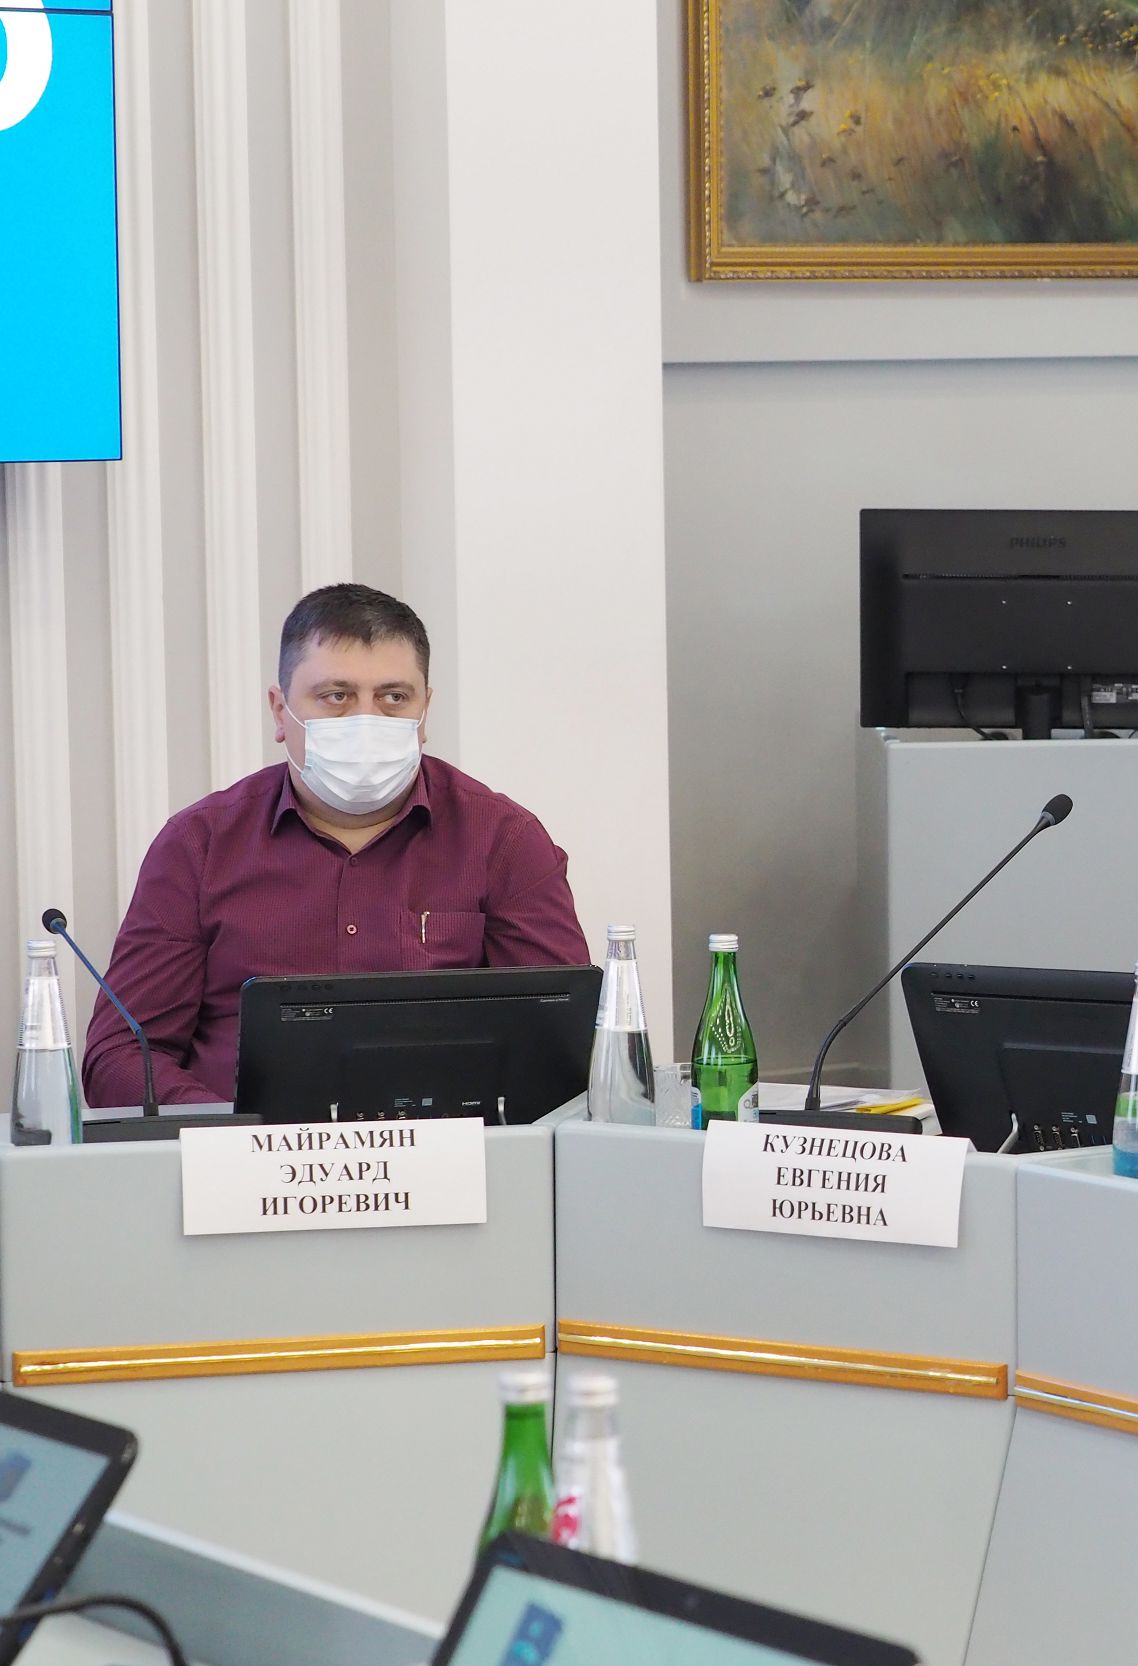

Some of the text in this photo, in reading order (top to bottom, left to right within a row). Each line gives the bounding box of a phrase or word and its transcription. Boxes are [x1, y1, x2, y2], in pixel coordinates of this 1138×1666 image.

[251, 1127, 416, 1153] МАЙРАМЯН
[762, 1134, 908, 1163] КУЗНЕЦОВА
[280, 1160, 390, 1186] ЭДУАРД
[775, 1166, 888, 1194] ЕВГЕНИЯ
[261, 1191, 411, 1216] ИГОРЕВИЧ
[770, 1198, 888, 1227] ЮРЬЕВНА
